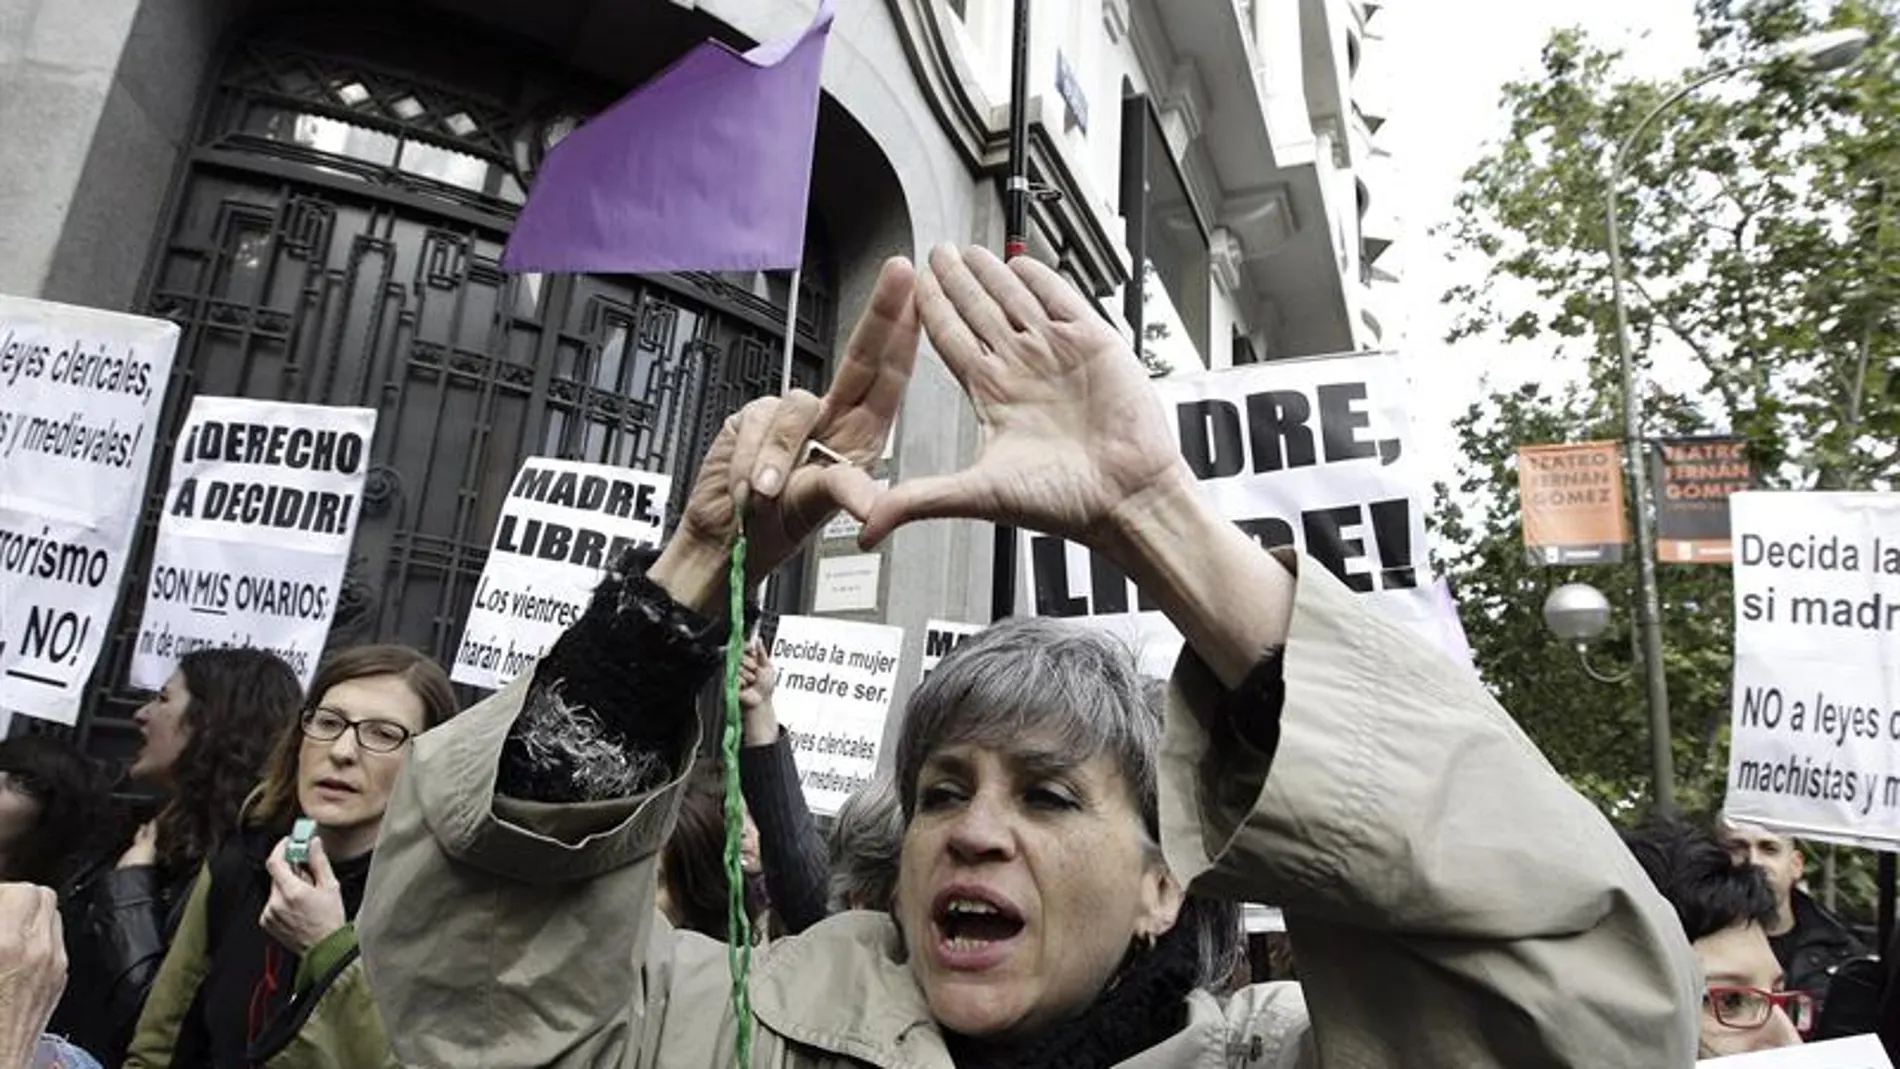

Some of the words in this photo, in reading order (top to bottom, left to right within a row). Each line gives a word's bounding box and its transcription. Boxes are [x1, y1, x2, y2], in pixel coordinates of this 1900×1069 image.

[51, 339, 153, 406] clericales,
[23, 412, 144, 469] medievales!
[172, 478, 199, 518] A
[201, 481, 355, 536] DECIDIR!
[512, 467, 661, 528] MADRE,
[1742, 533, 1859, 571] Decida
[152, 566, 192, 601] SON
[193, 570, 232, 608] MIS
[475, 576, 510, 614] Los
[1742, 586, 1775, 622] si
[19, 605, 91, 667] NO!
[459, 629, 502, 672] harán
[774, 638, 828, 663] Decida
[828, 643, 845, 666] la
[847, 650, 896, 676] mujer
[785, 673, 849, 698] madre
[853, 683, 888, 704] ser.
[1741, 686, 1783, 729] NO
[1790, 700, 1806, 732] a
[1814, 691, 1880, 747] leyes
[1737, 753, 1858, 802] machistas
[1861, 774, 1878, 815] y
